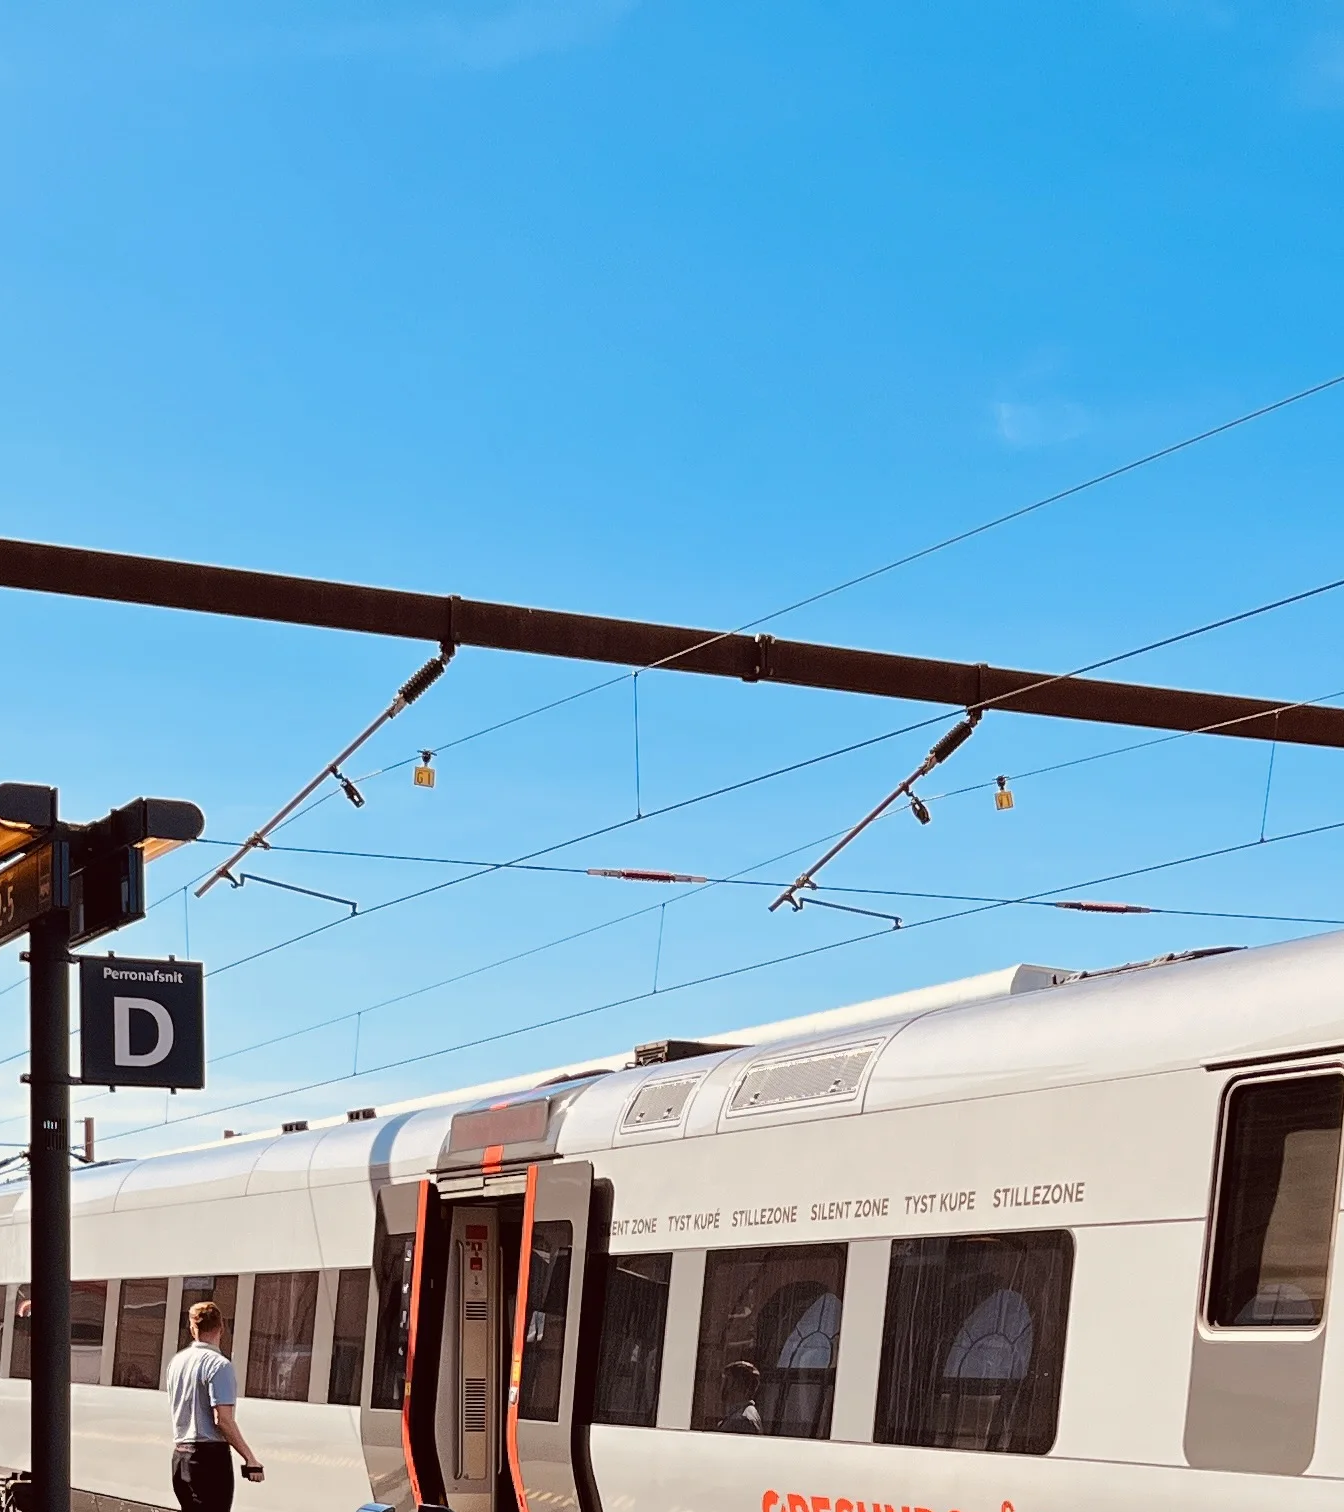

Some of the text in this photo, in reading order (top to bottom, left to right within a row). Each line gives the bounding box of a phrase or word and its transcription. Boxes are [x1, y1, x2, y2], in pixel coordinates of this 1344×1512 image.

[103, 966, 184, 984] Perronafsnit
[113, 996, 174, 1068] D
[631, 1217, 657, 1235] ZONE
[668, 1214, 692, 1232] TYST
[731, 1205, 798, 1228] STILLEZONE
[810, 1200, 852, 1221] SILENT
[854, 1198, 890, 1218] ZONE
[904, 1193, 937, 1215] TYST
[992, 1182, 1086, 1209] STILLEZONE
